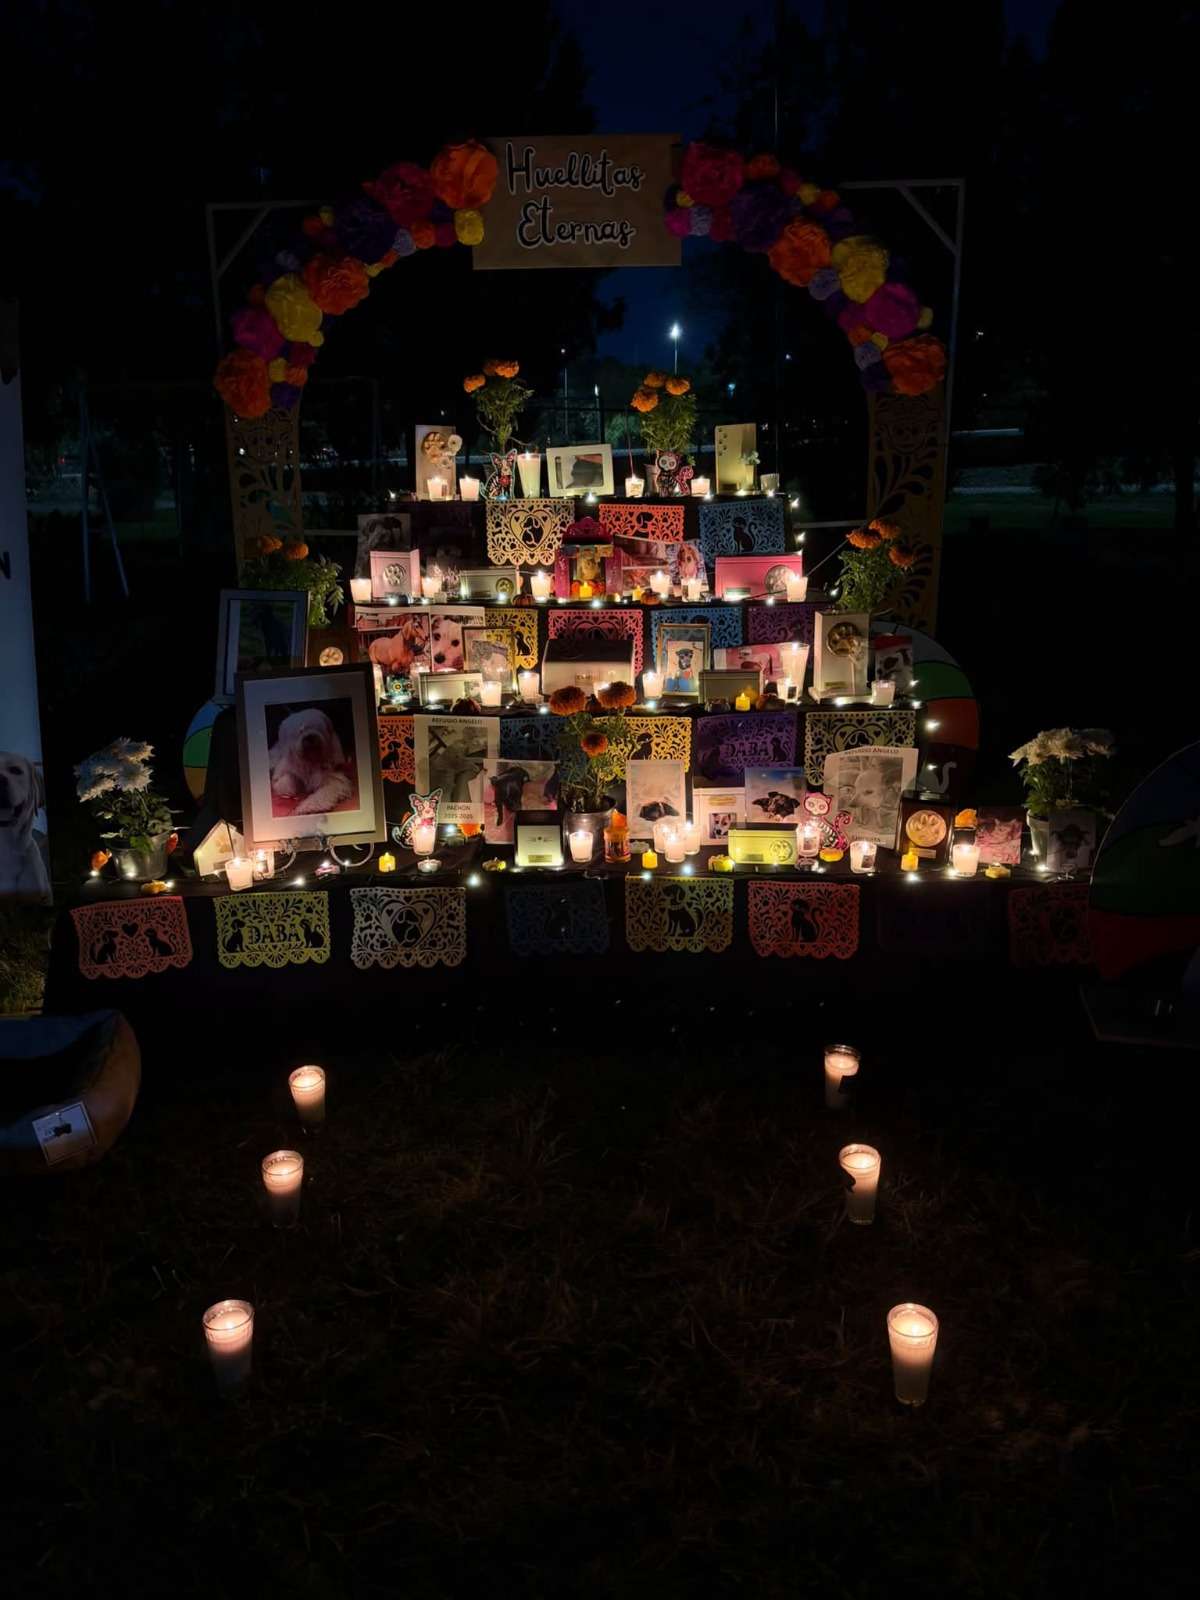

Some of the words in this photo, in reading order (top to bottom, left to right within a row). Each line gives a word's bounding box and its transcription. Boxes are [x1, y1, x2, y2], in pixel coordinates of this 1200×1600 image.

[506, 142, 646, 196] Huellitas
[517, 196, 638, 248] Eternas
[247, 924, 301, 944] DABA
